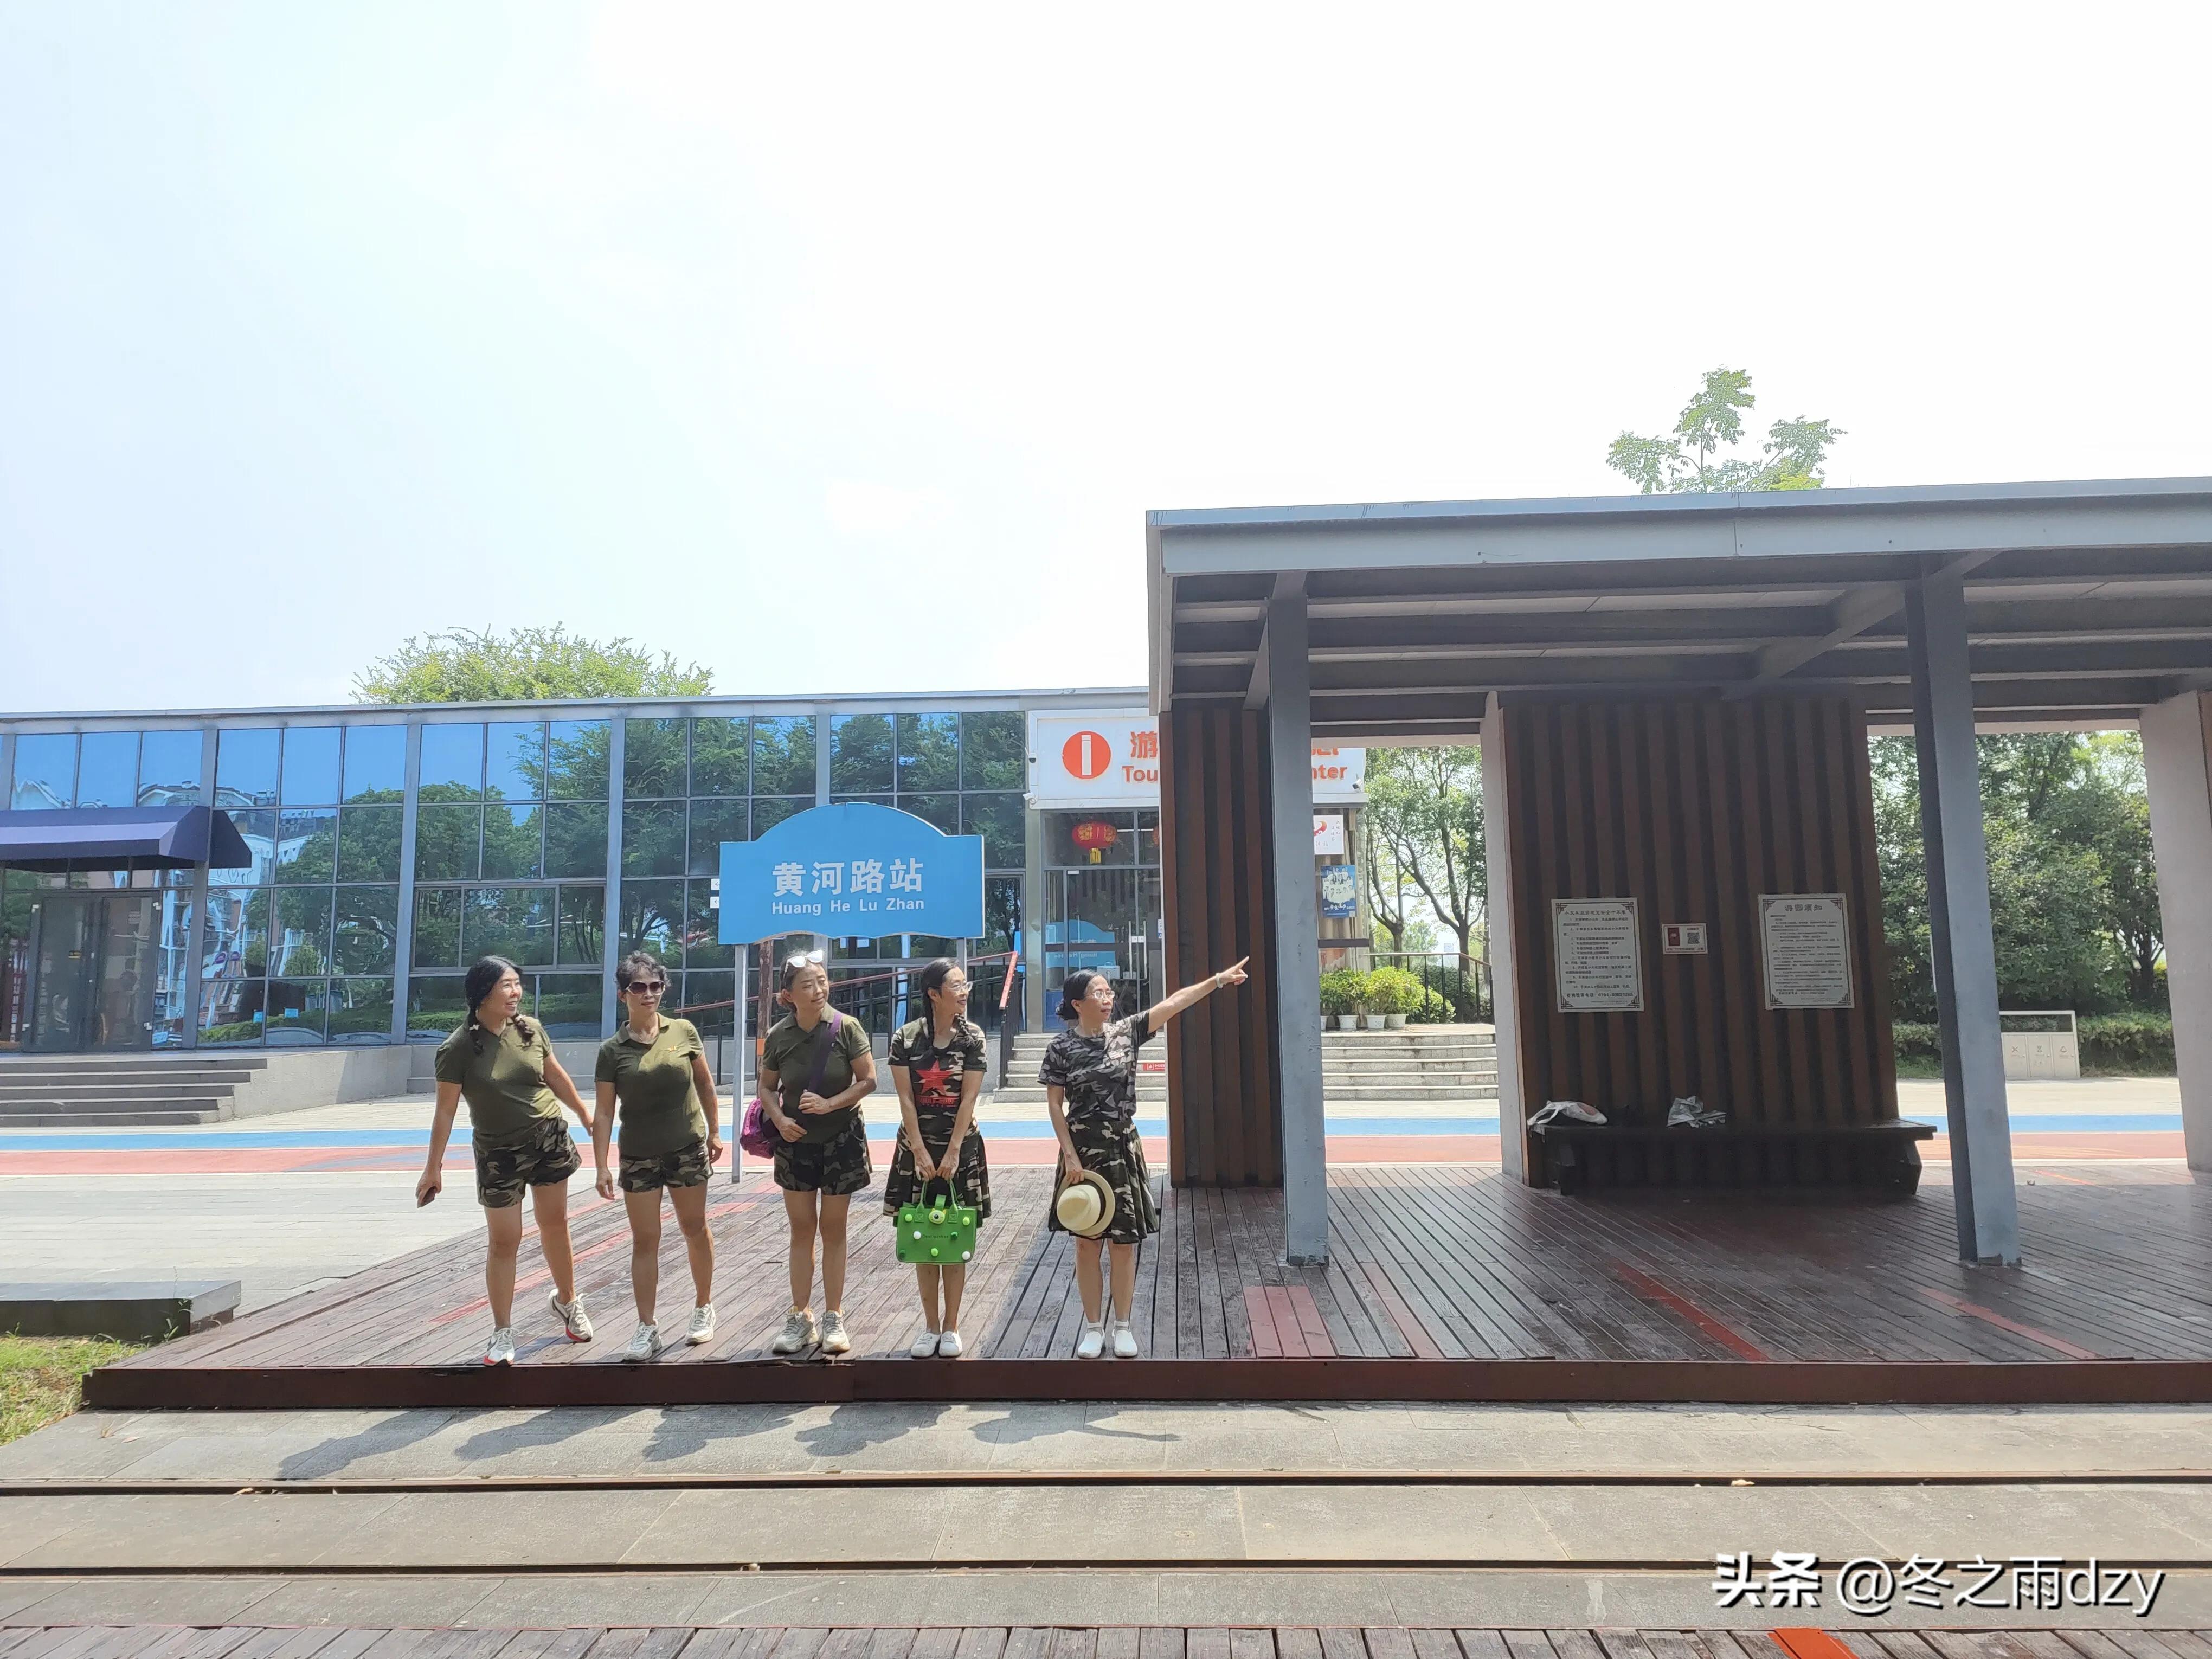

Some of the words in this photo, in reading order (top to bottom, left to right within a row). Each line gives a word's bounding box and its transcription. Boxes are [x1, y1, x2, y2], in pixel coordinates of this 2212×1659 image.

[772, 857, 924, 897] 黄河路站
[772, 902, 821, 916] Huang
[830, 899, 851, 912] He
[859, 898, 878, 911] Lu
[886, 897, 924, 910] Zhan
